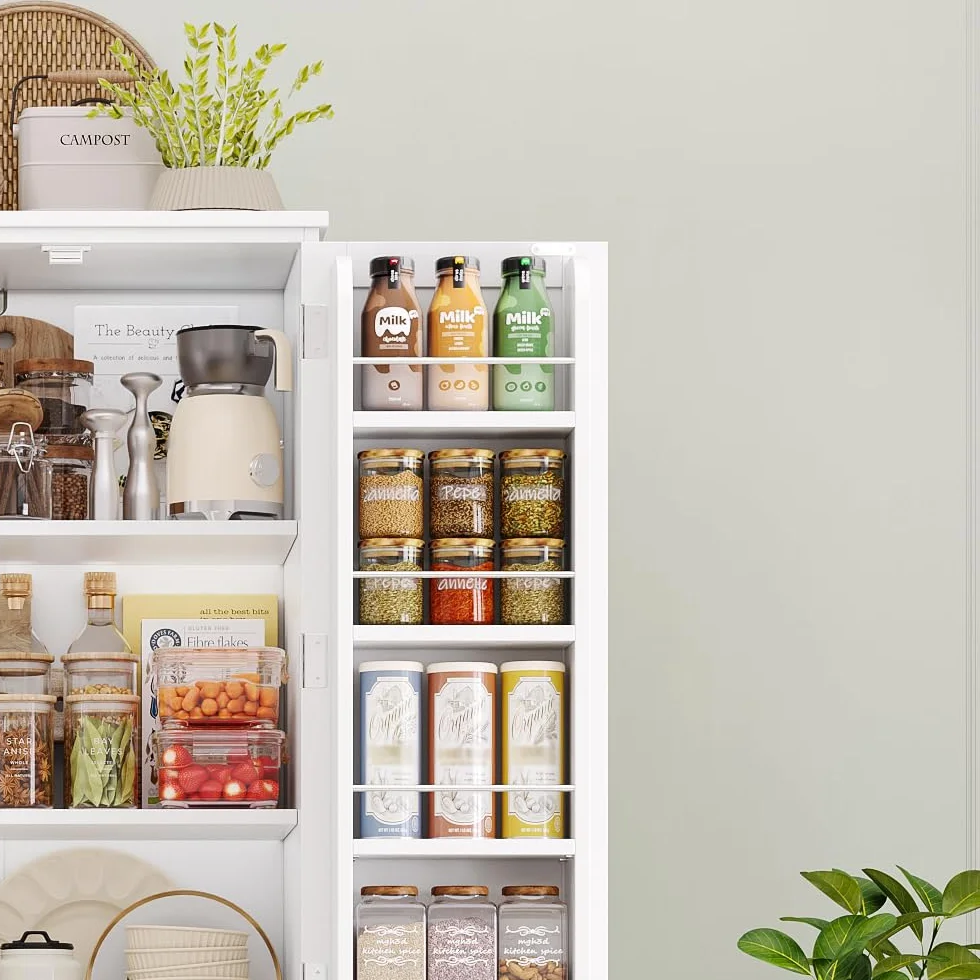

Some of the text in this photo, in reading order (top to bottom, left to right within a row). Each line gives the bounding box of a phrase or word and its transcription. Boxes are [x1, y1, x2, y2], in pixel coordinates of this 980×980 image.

[60, 134, 130, 146] CAMPOST
[380, 315, 407, 325] Milk
[440, 309, 475, 324] Milk
[506, 310, 542, 325] Milk
[95, 323, 121, 336] The
[126, 324, 175, 340] Beauty
[441, 485, 481, 500] Pepe
[187, 635, 249, 647] Fibre flakes
[6, 737, 32, 745] STAR
[93, 737, 114, 745] BAY
[82, 747, 123, 756] LEAVES
[362, 947, 421, 956] kitchen spice
[433, 947, 493, 956] kitchen spice
[503, 947, 564, 956] kitchen spice
